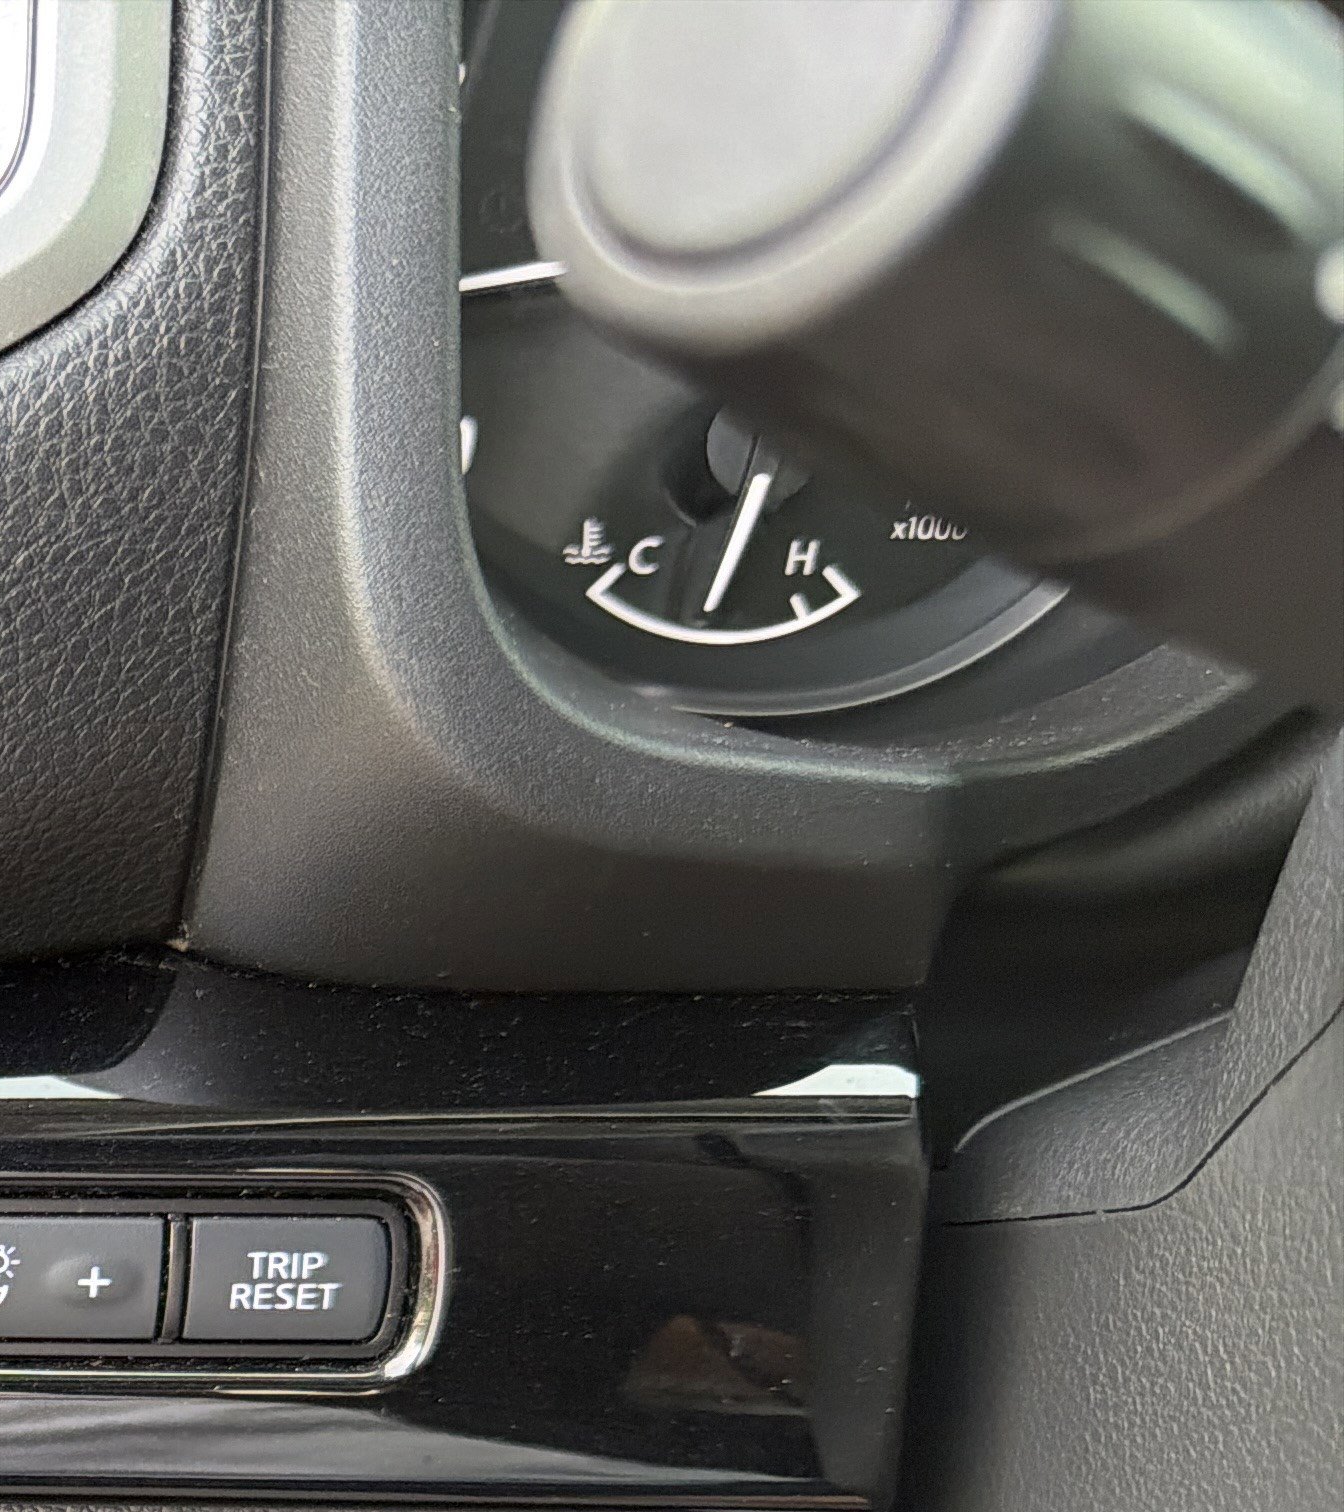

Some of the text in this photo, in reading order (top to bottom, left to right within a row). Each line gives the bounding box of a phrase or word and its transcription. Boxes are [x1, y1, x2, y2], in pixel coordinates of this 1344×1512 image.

[627, 535, 665, 576] C
[784, 538, 822, 576] H
[247, 1251, 327, 1277] TRIP
[229, 1282, 341, 1311] RESET
